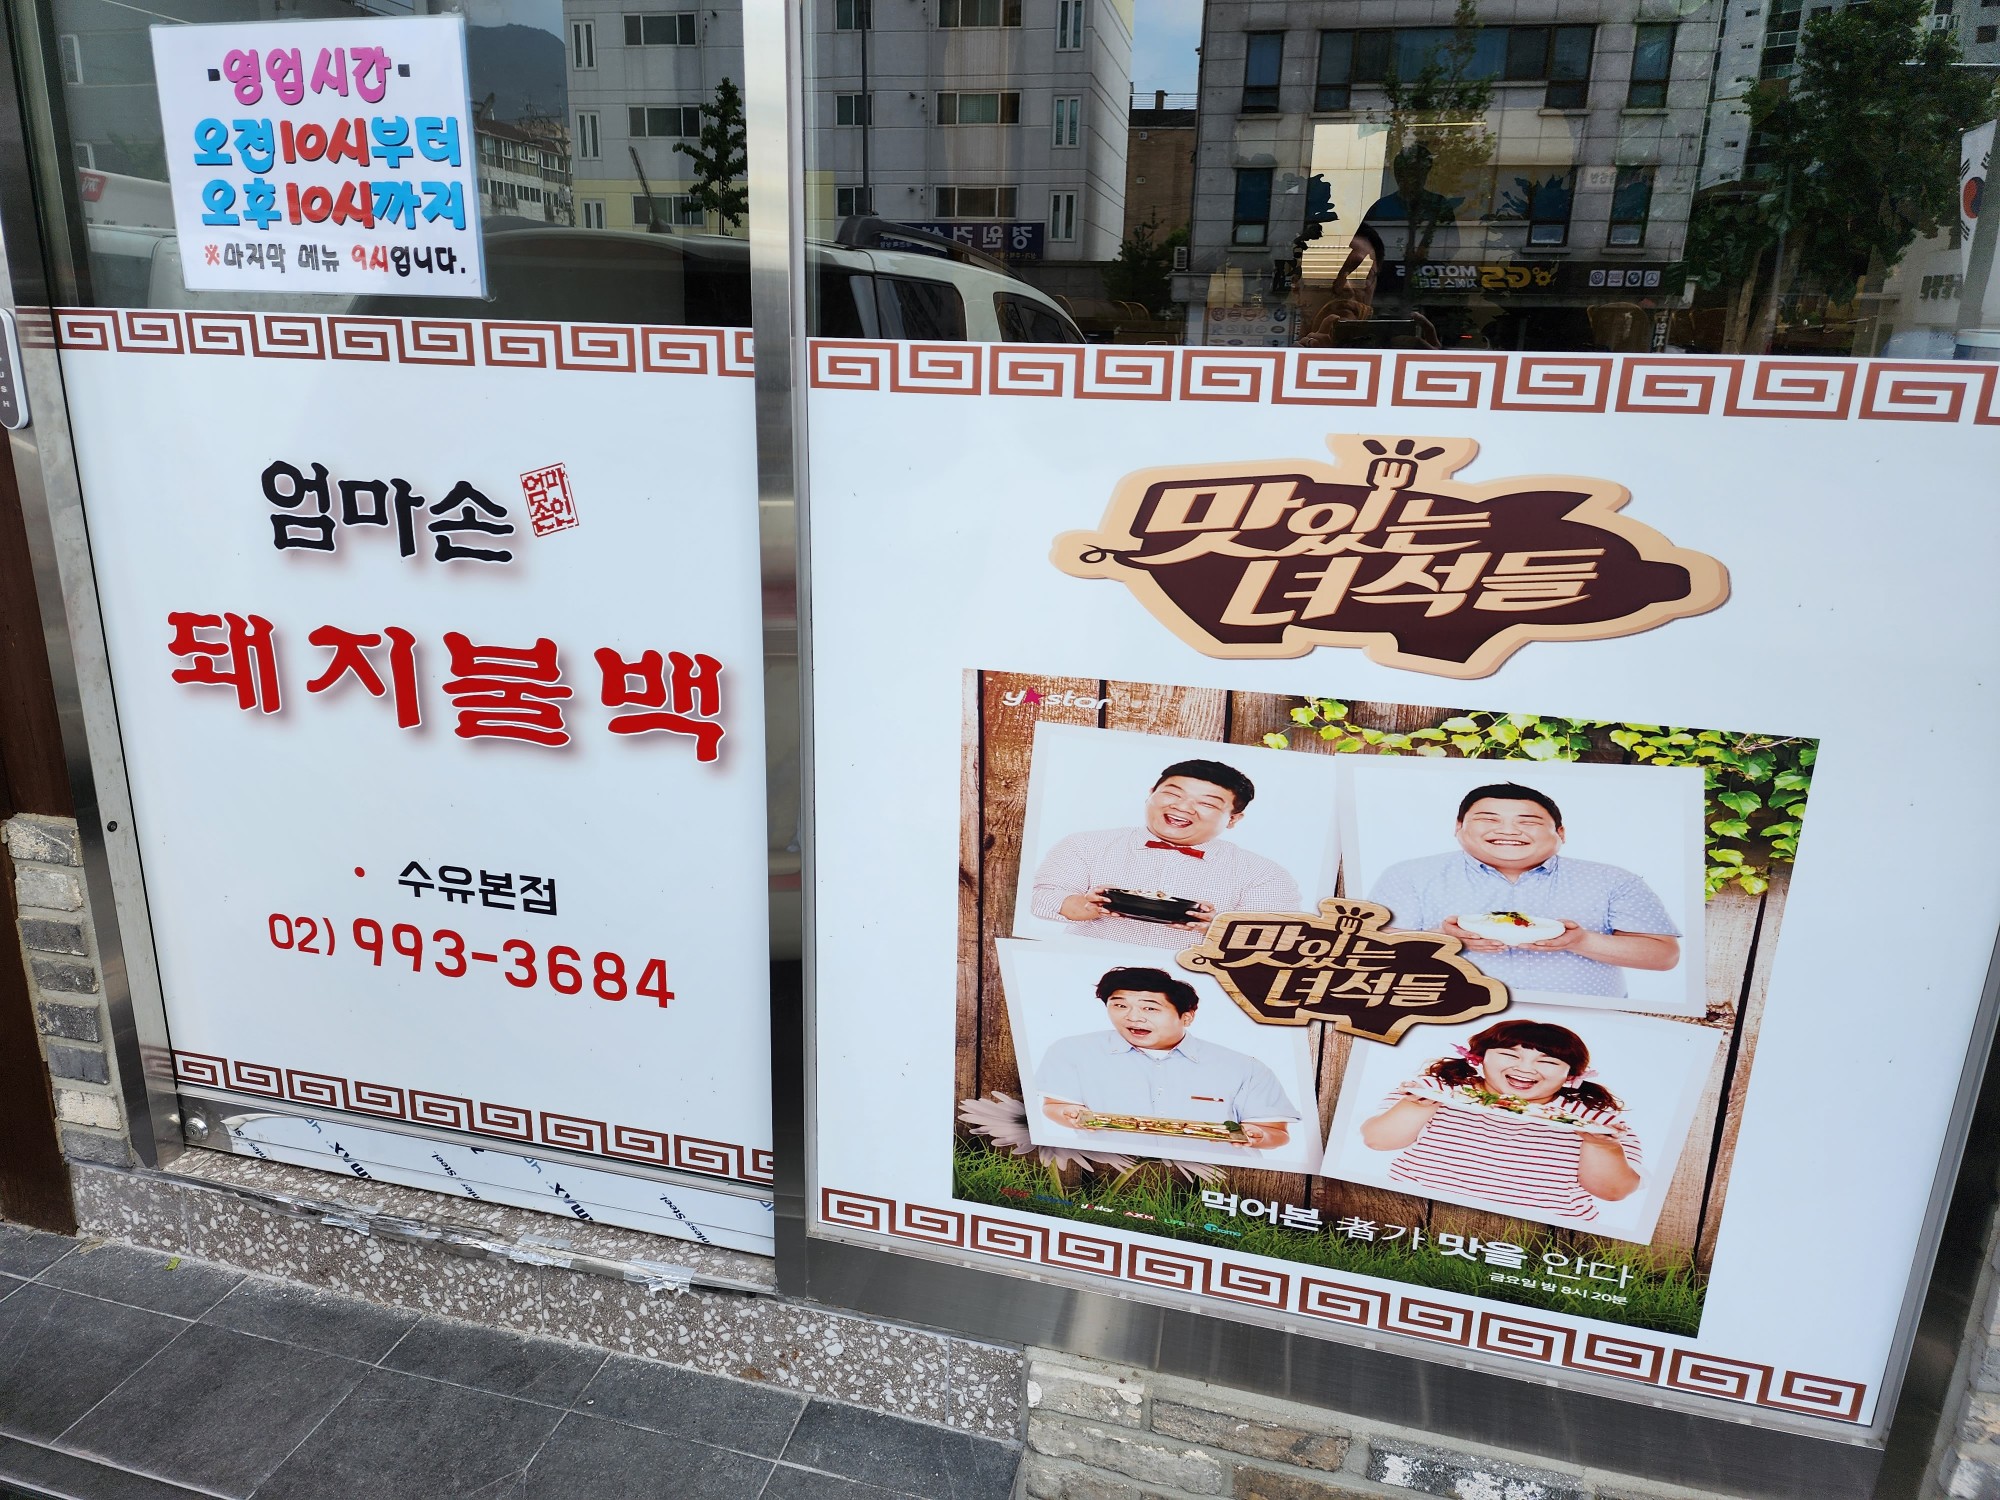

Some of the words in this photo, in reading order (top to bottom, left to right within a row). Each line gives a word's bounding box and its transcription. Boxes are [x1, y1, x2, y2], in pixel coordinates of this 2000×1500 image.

[223, 46, 391, 105] 영업시간
[298, 244, 340, 272] 메뉴
[260, 460, 515, 563] 엄마손
[1128, 459, 1492, 564] 맛있는
[1220, 547, 1606, 626] 녀석들
[167, 611, 725, 763] 돼지불백
[398, 861, 558, 916] 수유본점
[268, 912, 336, 956] 02)
[352, 917, 675, 1009] 993-3684
[1219, 916, 1397, 972] 맛있는
[1264, 969, 1450, 1008] 녀석들
[1202, 1190, 1322, 1232] 먹어본
[1438, 1233, 1528, 1270] 맛을
[1542, 1252, 1634, 1290] 안다
[1489, 1272, 1537, 1289] 금요일
[1541, 1281, 1557, 1293] 밤
[1561, 1286, 1587, 1299] 8시
[1591, 1292, 1629, 1306] 20분
